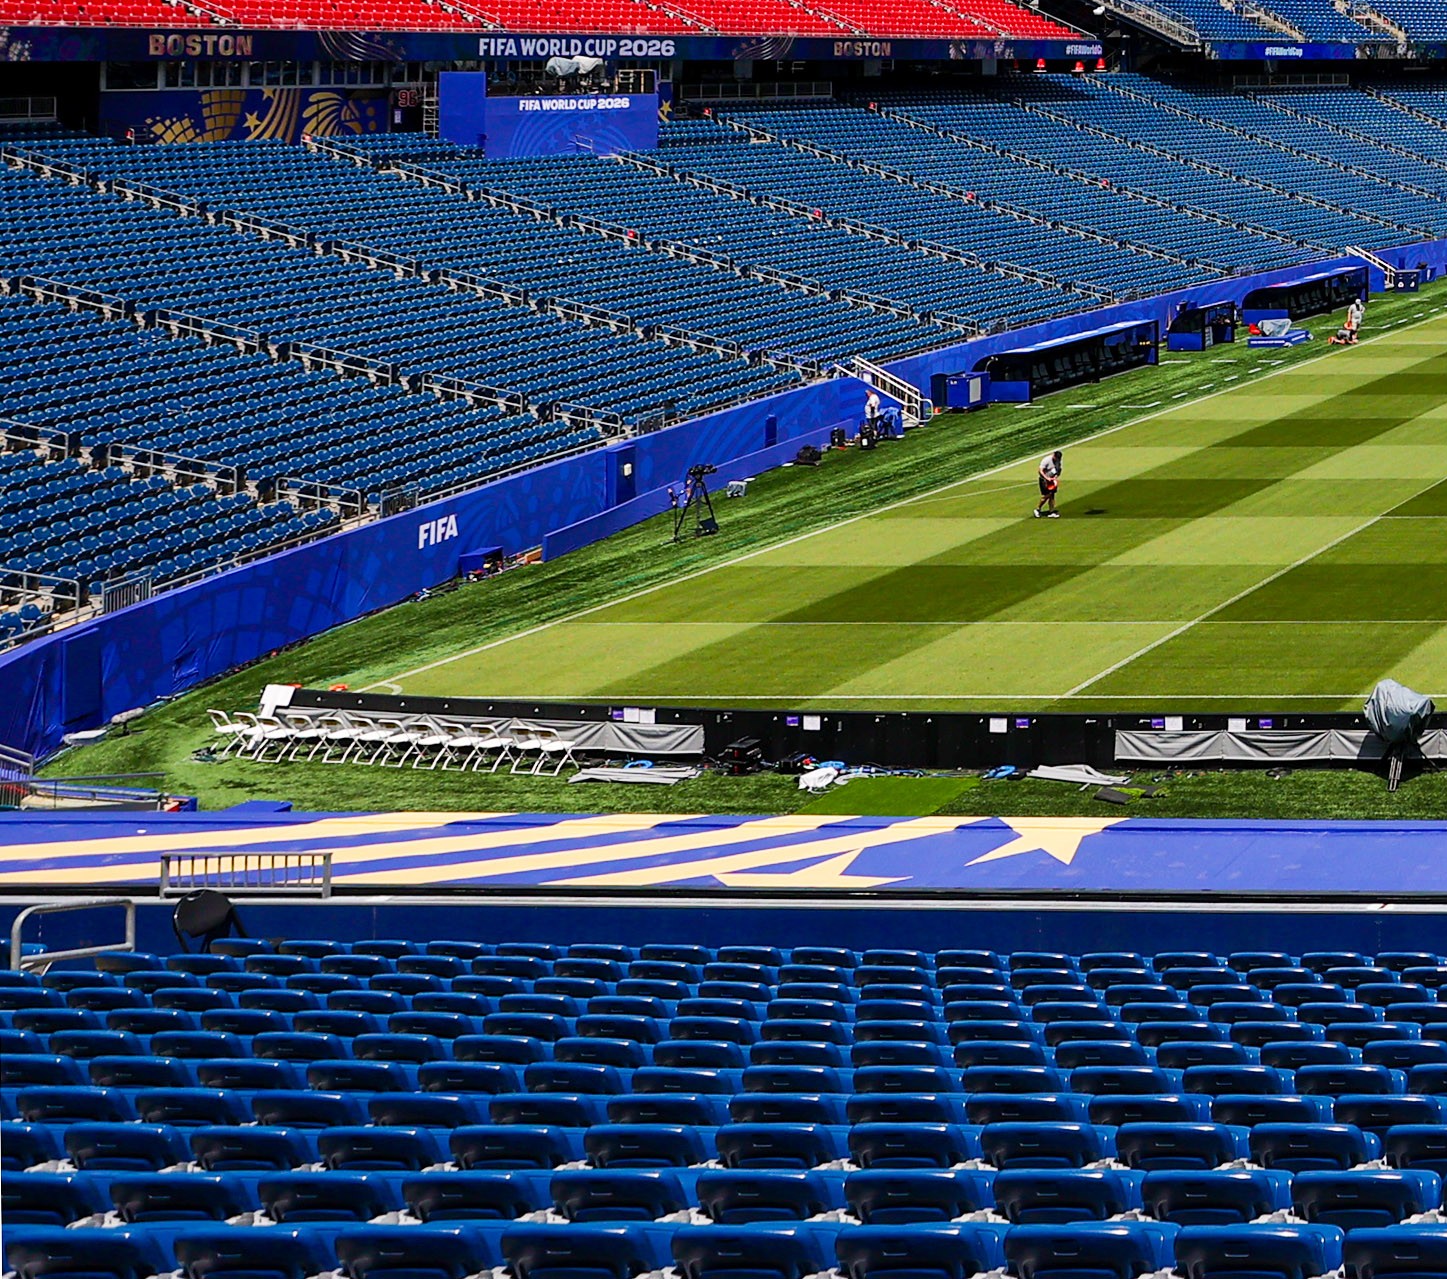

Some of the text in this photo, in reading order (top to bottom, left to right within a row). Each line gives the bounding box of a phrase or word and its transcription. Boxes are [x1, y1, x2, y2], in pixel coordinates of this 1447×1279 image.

[149, 34, 253, 56] BOSTON
[479, 38, 676, 57] FIFA WORLD CUP 2026
[833, 41, 891, 57] BOSTON
[519, 97, 630, 111] FIFA WORLD CUP 2026
[418, 514, 458, 550] FIFA
